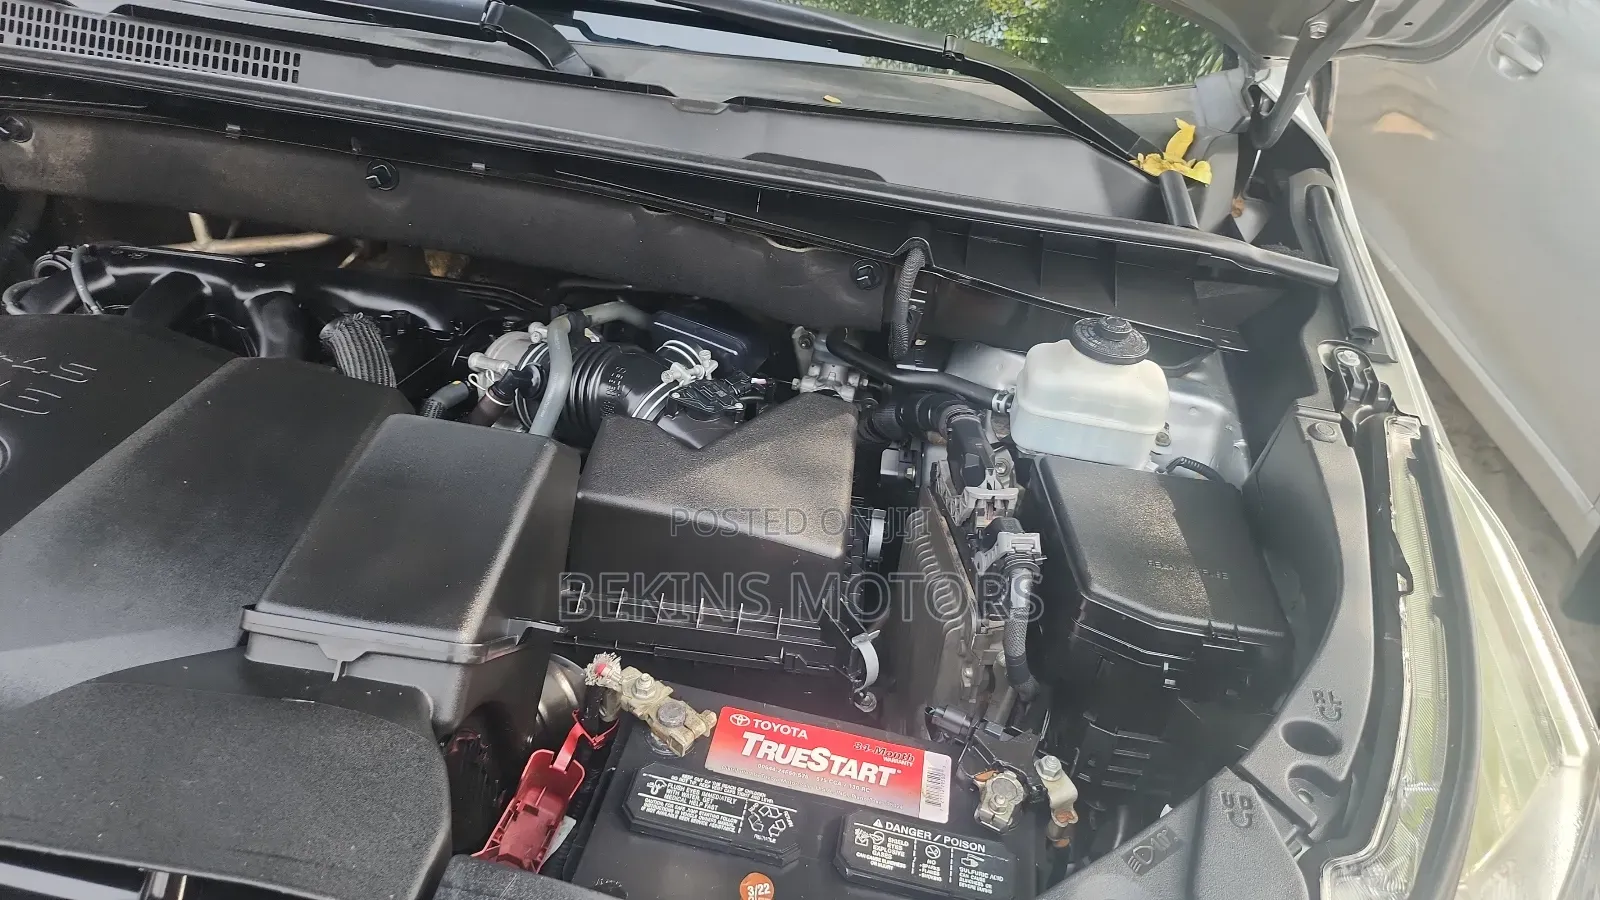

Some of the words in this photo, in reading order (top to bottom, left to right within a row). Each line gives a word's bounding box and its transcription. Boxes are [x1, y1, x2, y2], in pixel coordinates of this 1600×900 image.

[753, 718, 808, 740] TOYOTA
[883, 757, 913, 767] WARRANTY
[666, 788, 680, 796] WITH
[702, 796, 714, 804] GET
[667, 782, 686, 792] FLUSH
[686, 787, 701, 796] EYES
[701, 790, 737, 805] IMMEDIATELY
[664, 793, 688, 804] MEDICAL
[688, 799, 704, 808] HELP
[704, 802, 718, 811] FAST
[656, 809, 678, 819] AVAILABLE
[680, 811, 698, 819] VEHICLE
[884, 822, 933, 840] DANGER
[933, 834, 941, 842] /
[943, 836, 986, 853] POISON
[887, 837, 909, 846] SHIELD
[871, 850, 893, 859] GASES
[872, 845, 906, 857] EXPLOSIVE
[866, 854, 881, 862] CAUSE
[881, 858, 907, 869] BLINDNESS
[877, 862, 893, 870] INJURY
[958, 867, 989, 878] SULFURIC
[989, 874, 1004, 882] ACID
[970, 875, 986, 883] CAUSE
[959, 877, 984, 887] BLINDNESS
[747, 883, 770, 896] 3/22
